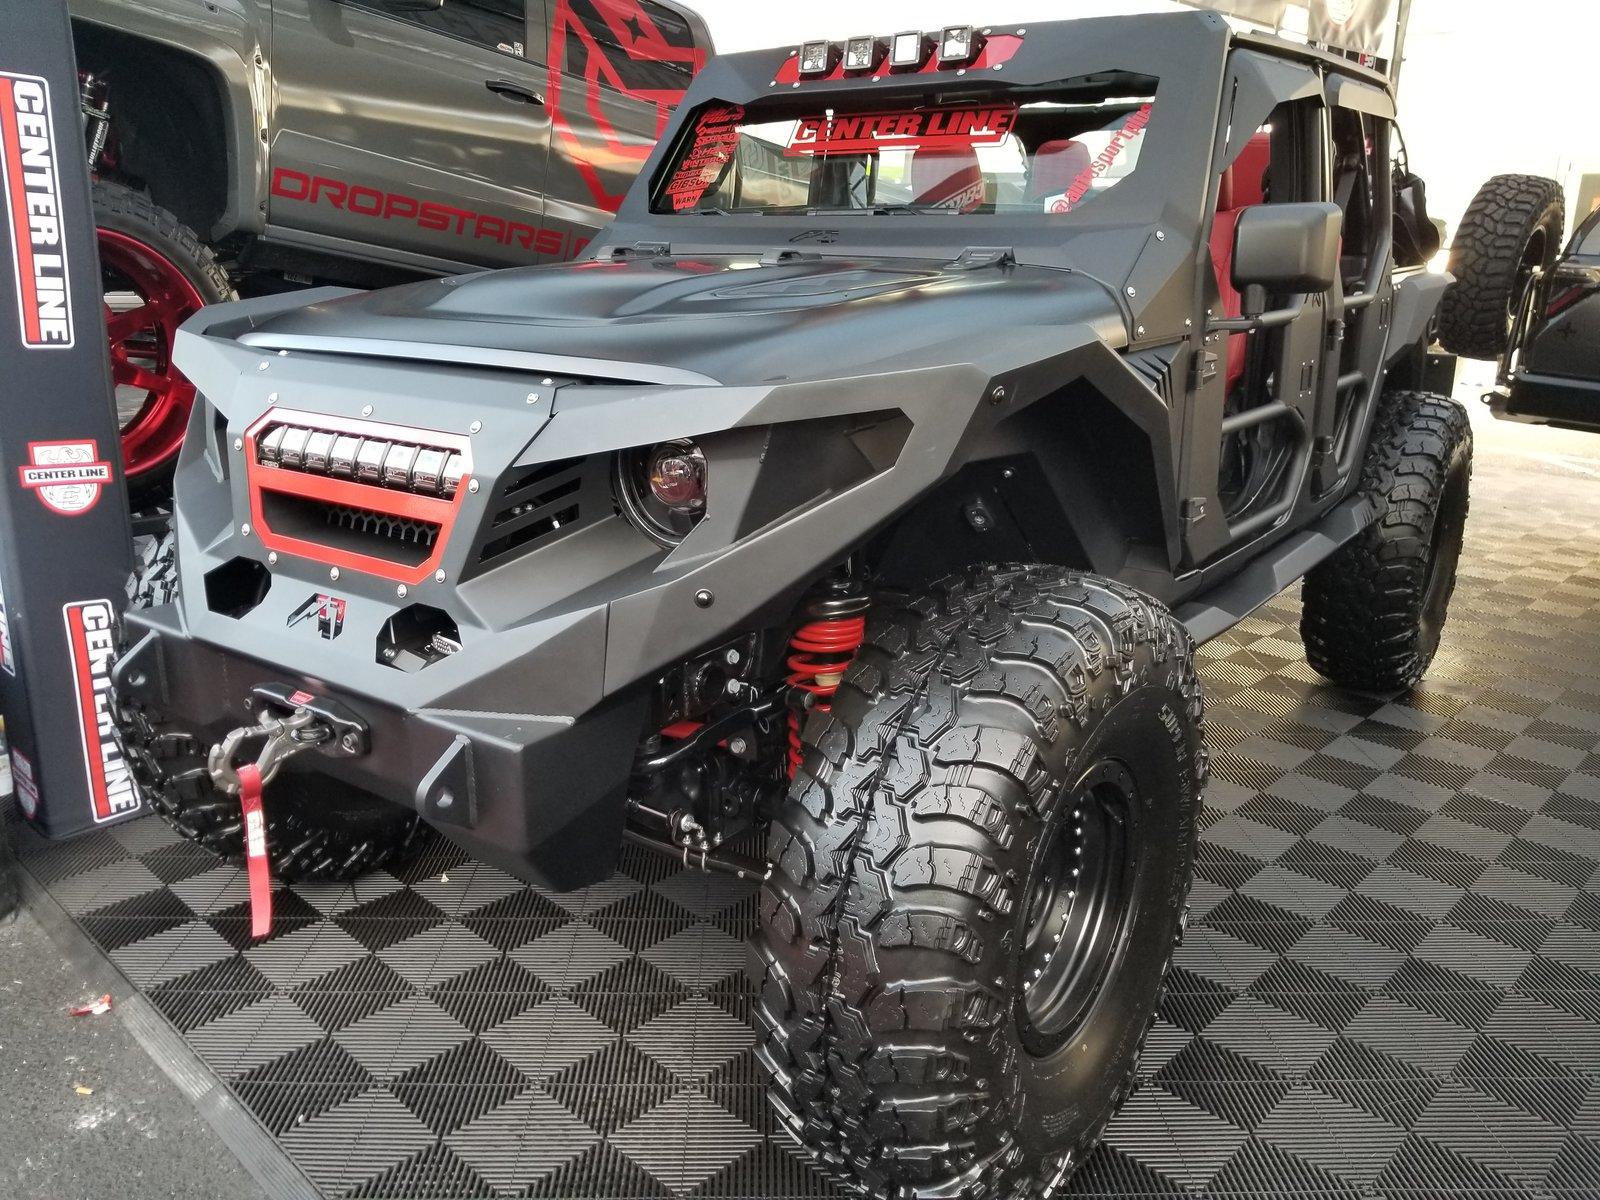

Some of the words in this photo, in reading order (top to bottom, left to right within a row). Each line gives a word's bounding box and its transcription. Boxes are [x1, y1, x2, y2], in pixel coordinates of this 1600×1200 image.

[13, 80, 59, 245] CENTER
[795, 114, 921, 141] CENTER
[926, 109, 1012, 136] LINE
[271, 166, 564, 256] DROPSTARS
[33, 253, 69, 343] LINE
[28, 469, 77, 480] CENTER
[79, 467, 106, 478] LINE
[100, 742, 136, 814] LINE
